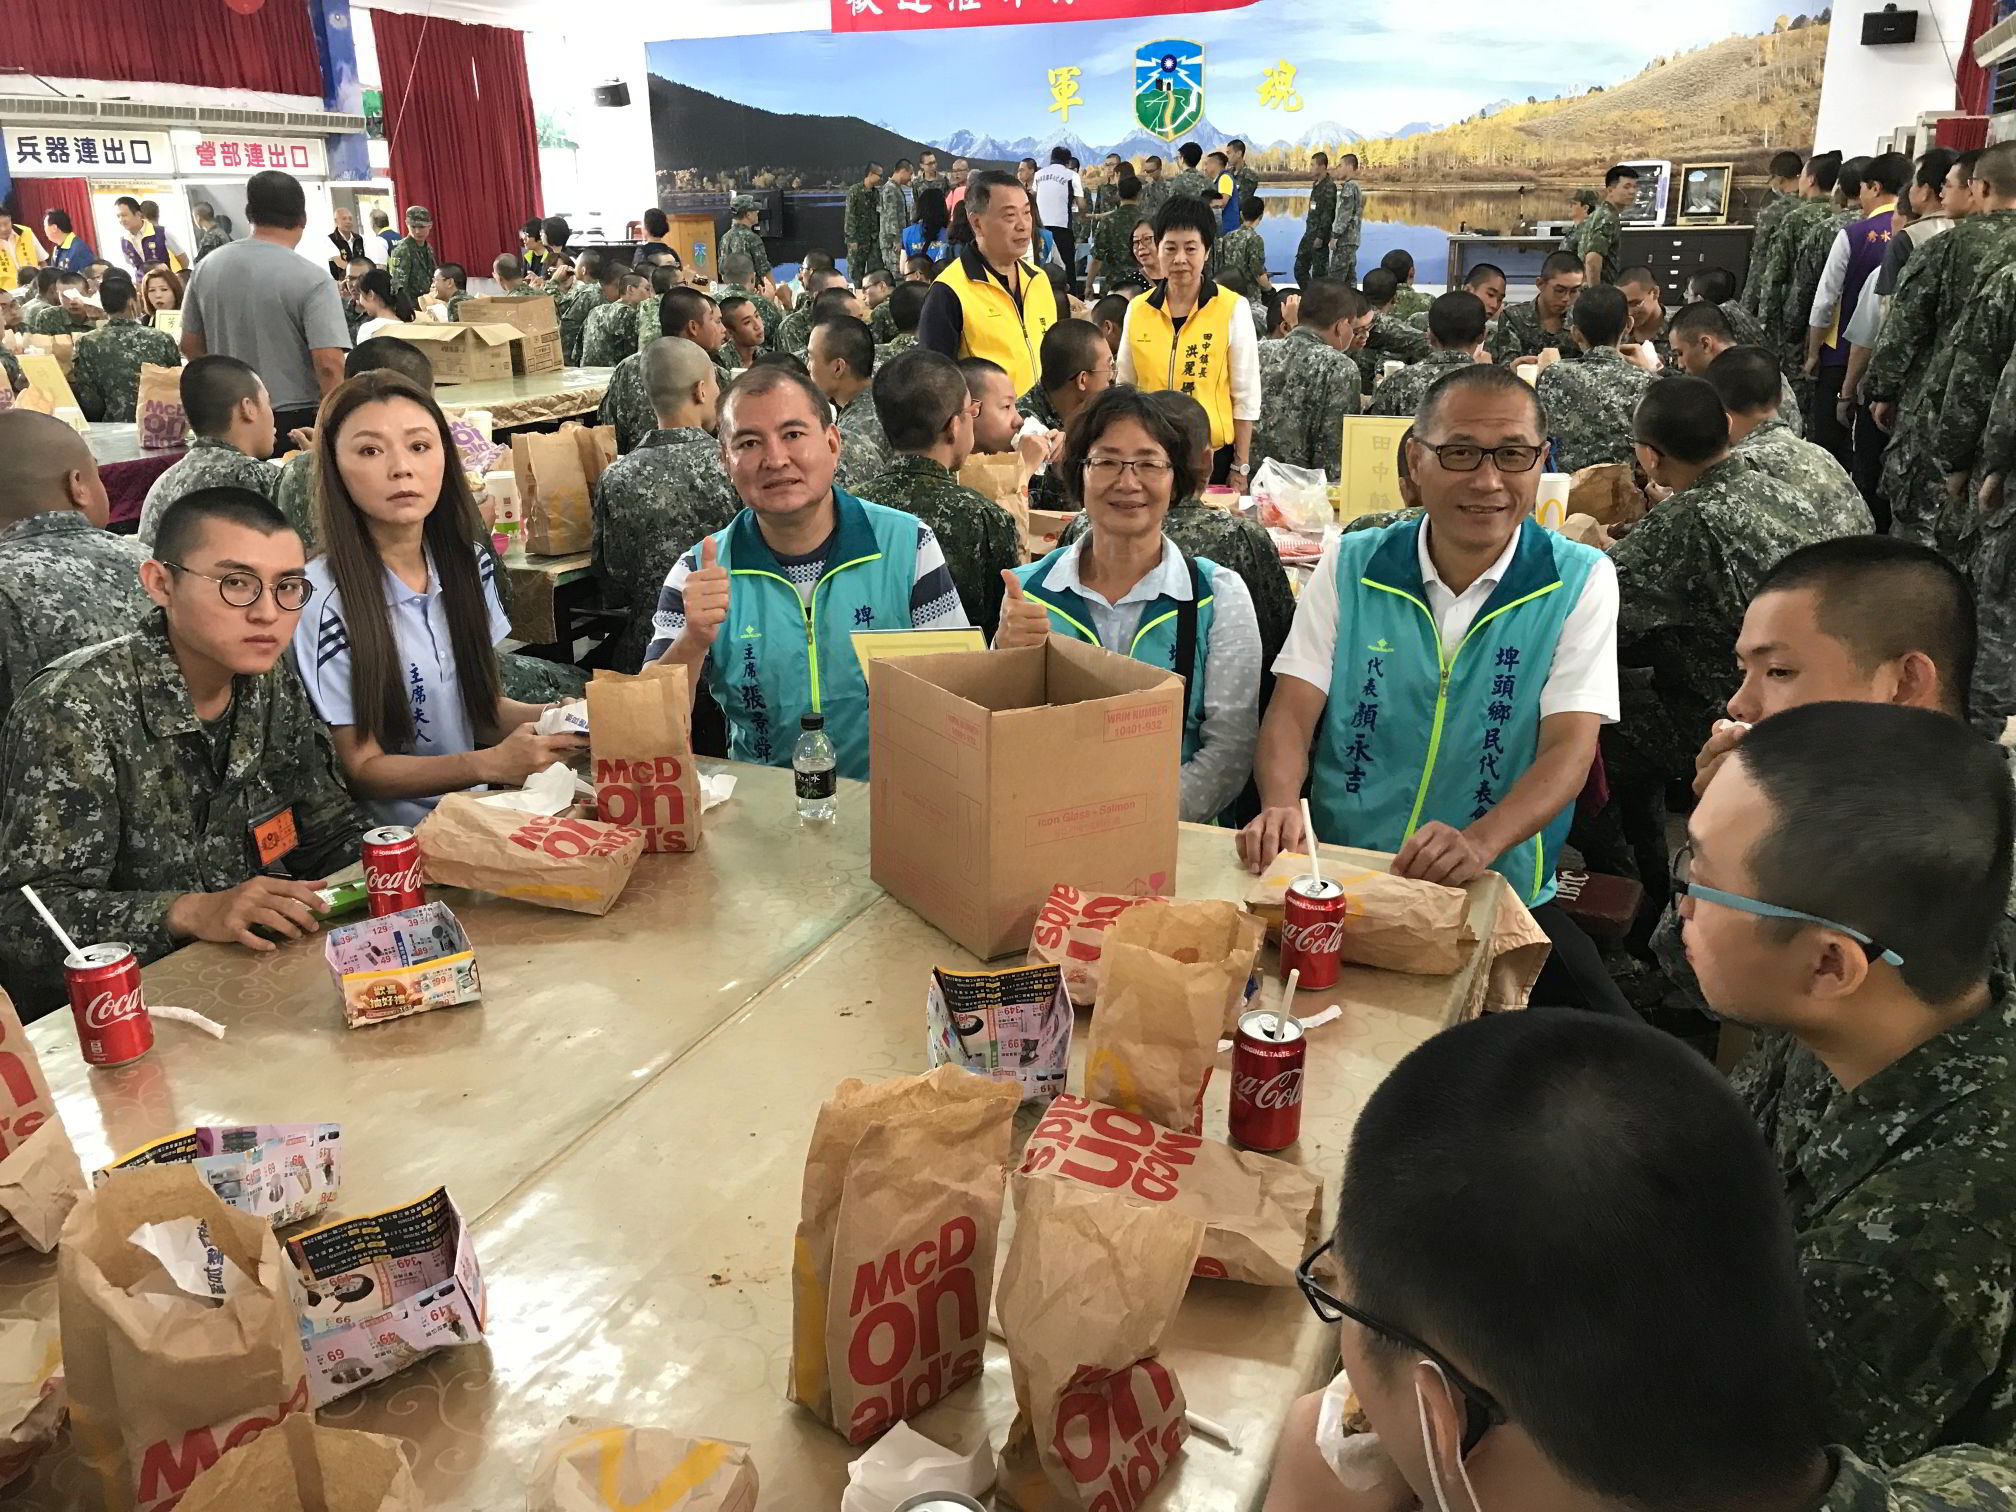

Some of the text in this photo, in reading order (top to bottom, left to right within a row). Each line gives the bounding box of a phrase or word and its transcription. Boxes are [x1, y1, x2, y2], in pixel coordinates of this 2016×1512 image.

[1047, 59, 1304, 122] 軍 魂
[16, 135, 153, 164] 兵器連出口
[195, 140, 310, 168] 營部連出口
[410, 662, 433, 743] 主席夫人
[596, 756, 682, 784] McD
[596, 783, 685, 826] on
[1060, 1105, 1160, 1190] on
[1130, 1131, 1203, 1202] McD
[849, 1216, 977, 1318] McD
[847, 1266, 981, 1386] on
[849, 1348, 981, 1446] ald's
